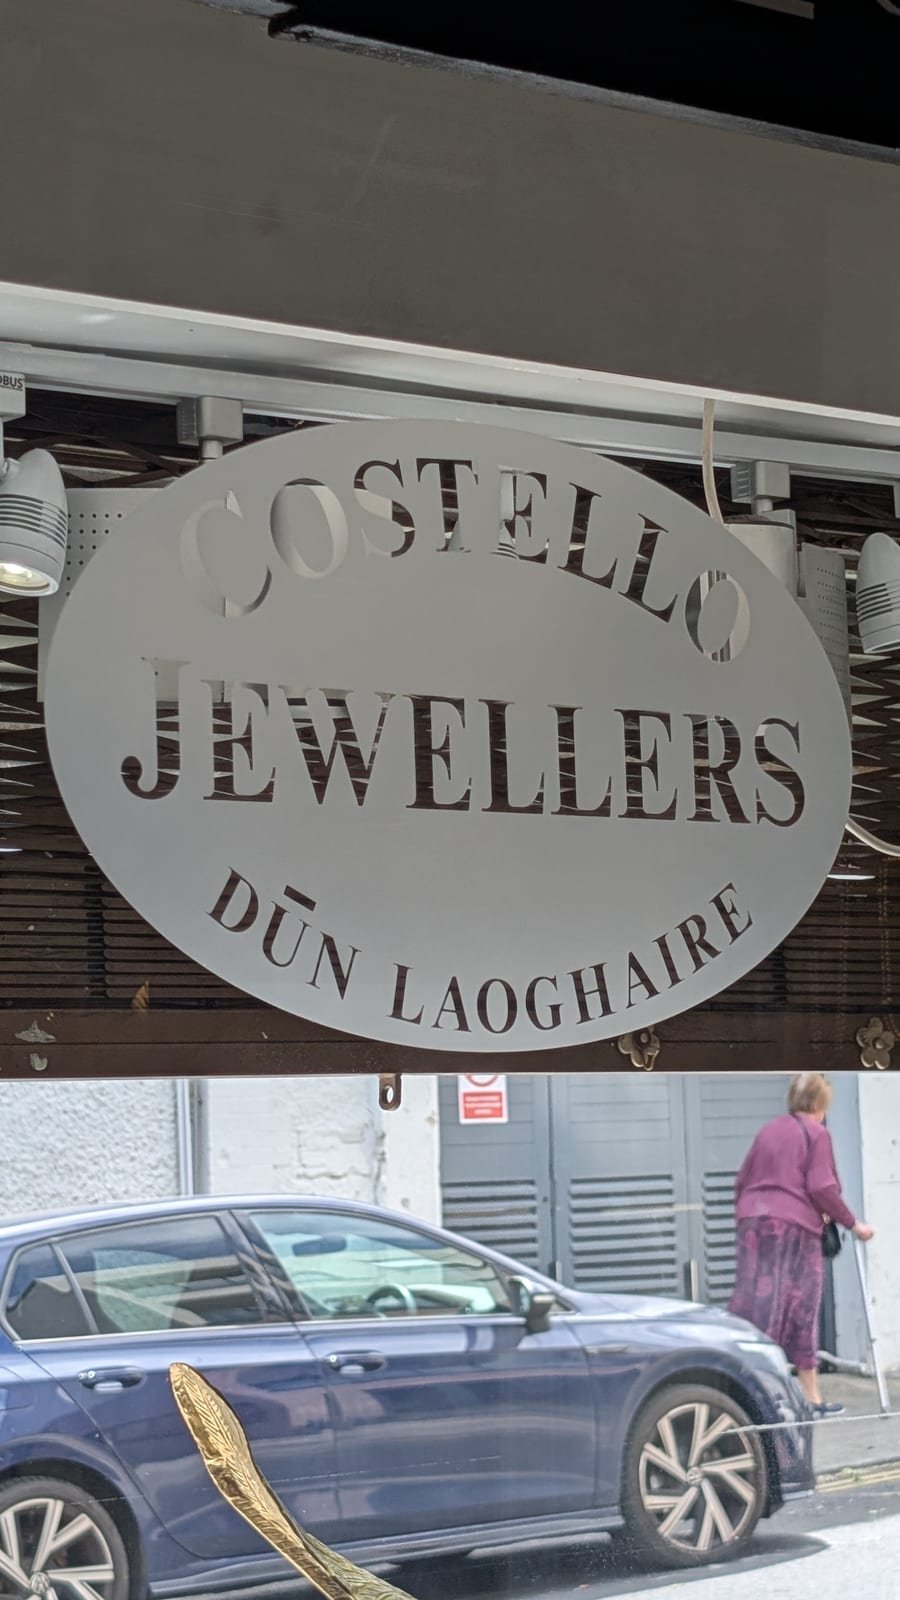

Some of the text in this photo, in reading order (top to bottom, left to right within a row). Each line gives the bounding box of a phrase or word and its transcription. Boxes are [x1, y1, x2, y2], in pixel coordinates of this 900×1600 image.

[180, 457, 750, 662] COSTELLO
[120, 657, 805, 827] JEWELLERS
[386, 882, 753, 1034] LAOGHAIRE
